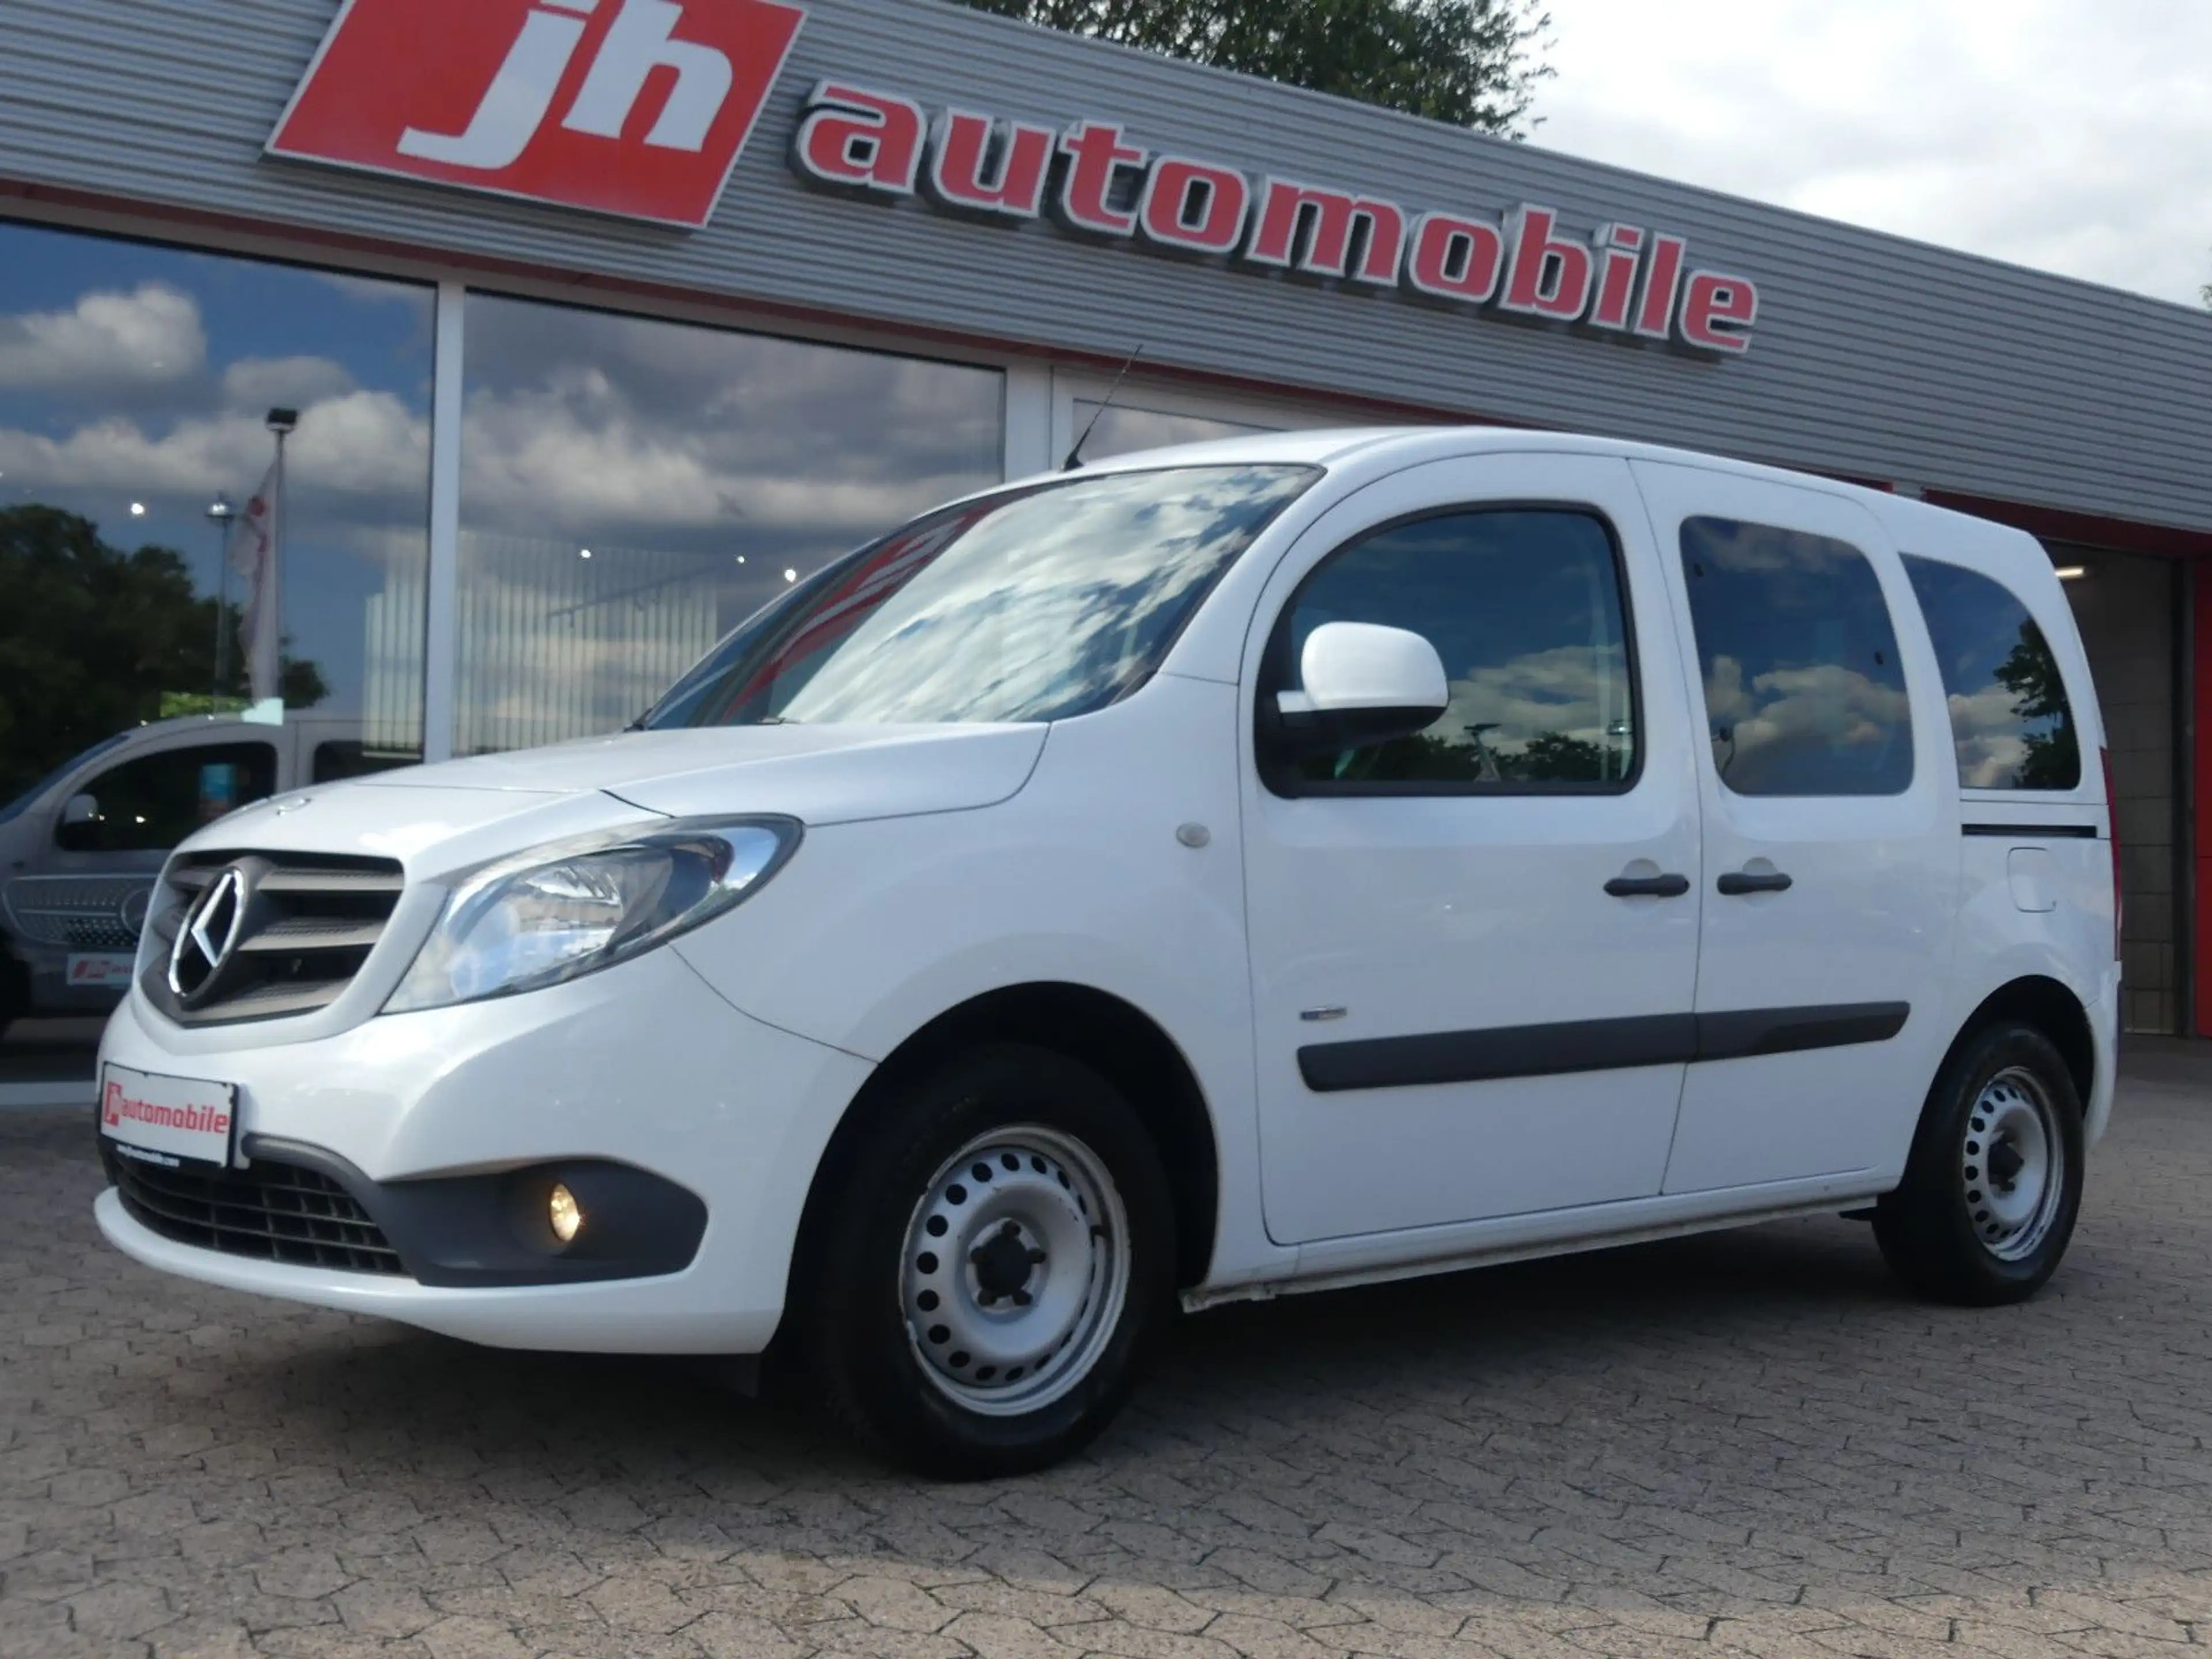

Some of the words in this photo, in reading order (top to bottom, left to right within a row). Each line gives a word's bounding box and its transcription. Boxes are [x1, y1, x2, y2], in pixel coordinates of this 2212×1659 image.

[396, 0, 733, 170] jh
[796, 78, 1760, 354] automobile
[122, 1099, 229, 1134] automobile
